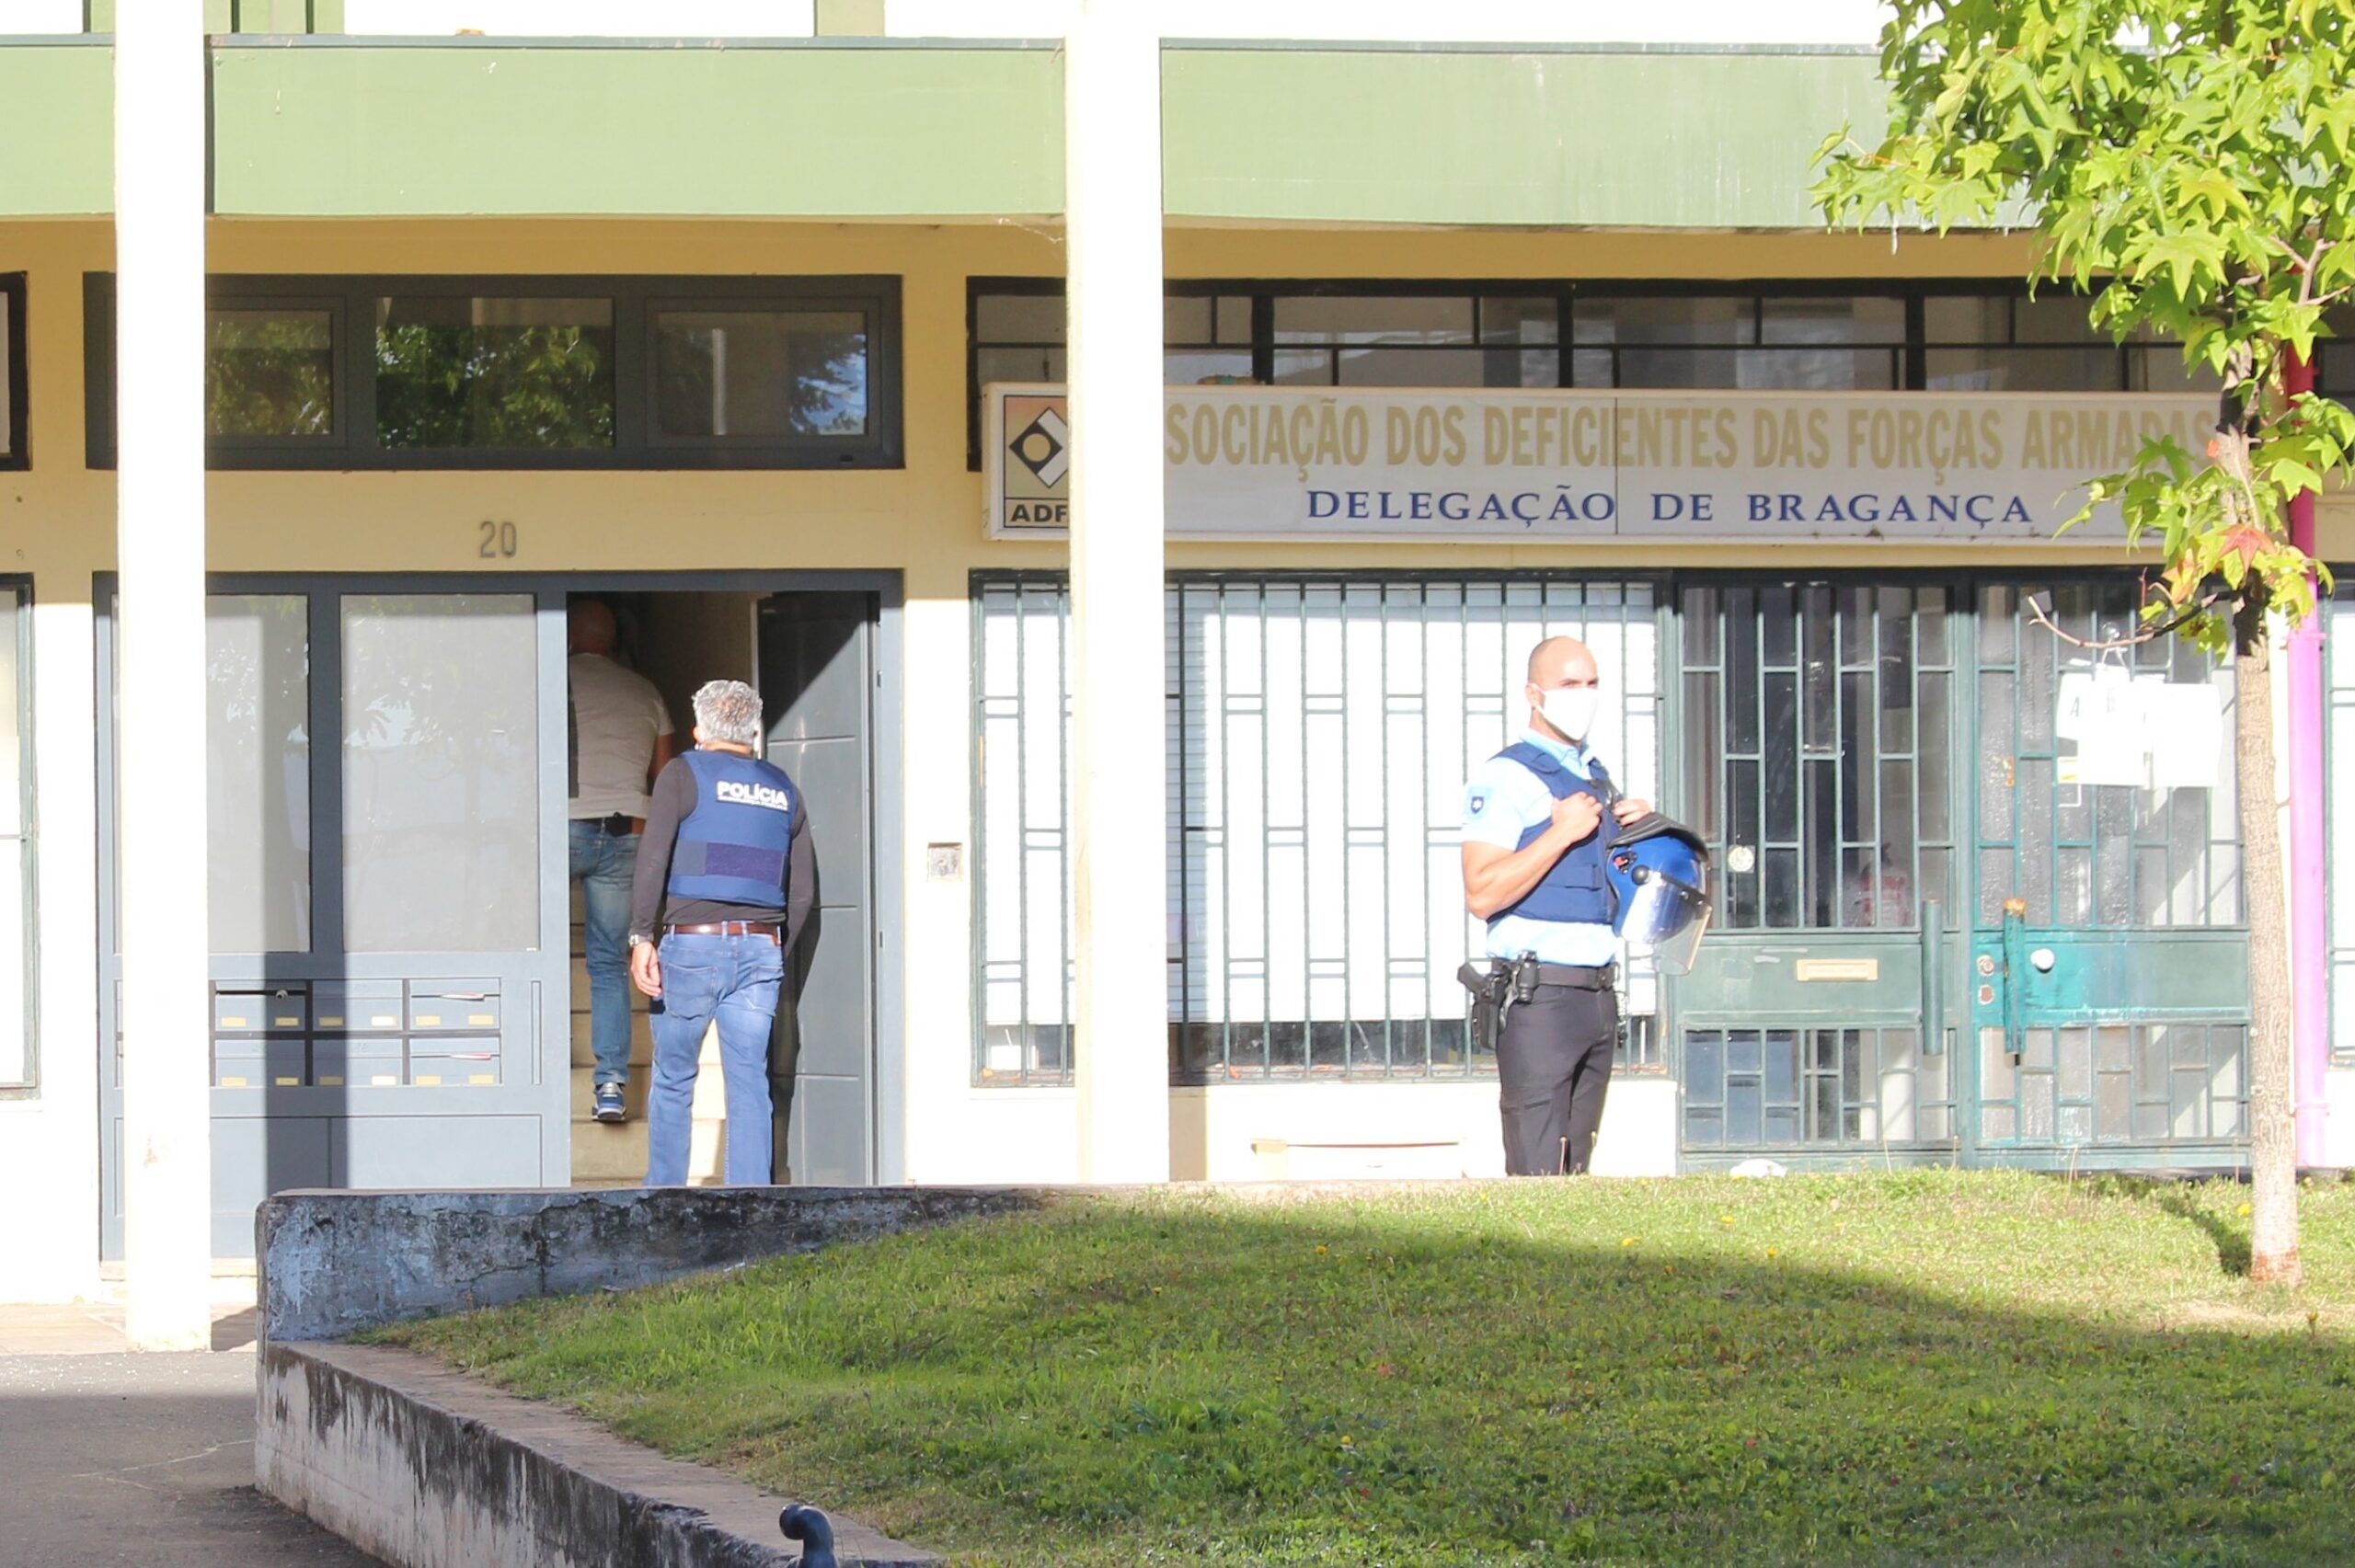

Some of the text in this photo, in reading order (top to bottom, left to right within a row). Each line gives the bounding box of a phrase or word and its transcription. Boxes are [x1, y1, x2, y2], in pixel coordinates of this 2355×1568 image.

[1166, 395, 1370, 484] SOCIAÇÃO
[1385, 405, 1467, 466] DOS
[1483, 405, 1740, 469] DEFICIENTES
[1752, 407, 1831, 470] DAS
[1846, 408, 2004, 486] FORÇAS
[1010, 503, 1069, 523] ADF
[1306, 484, 2033, 530] DELEGAÇÃO DE BRAGANÇA
[479, 521, 517, 558] 20
[717, 780, 789, 807] POLÍCIA
